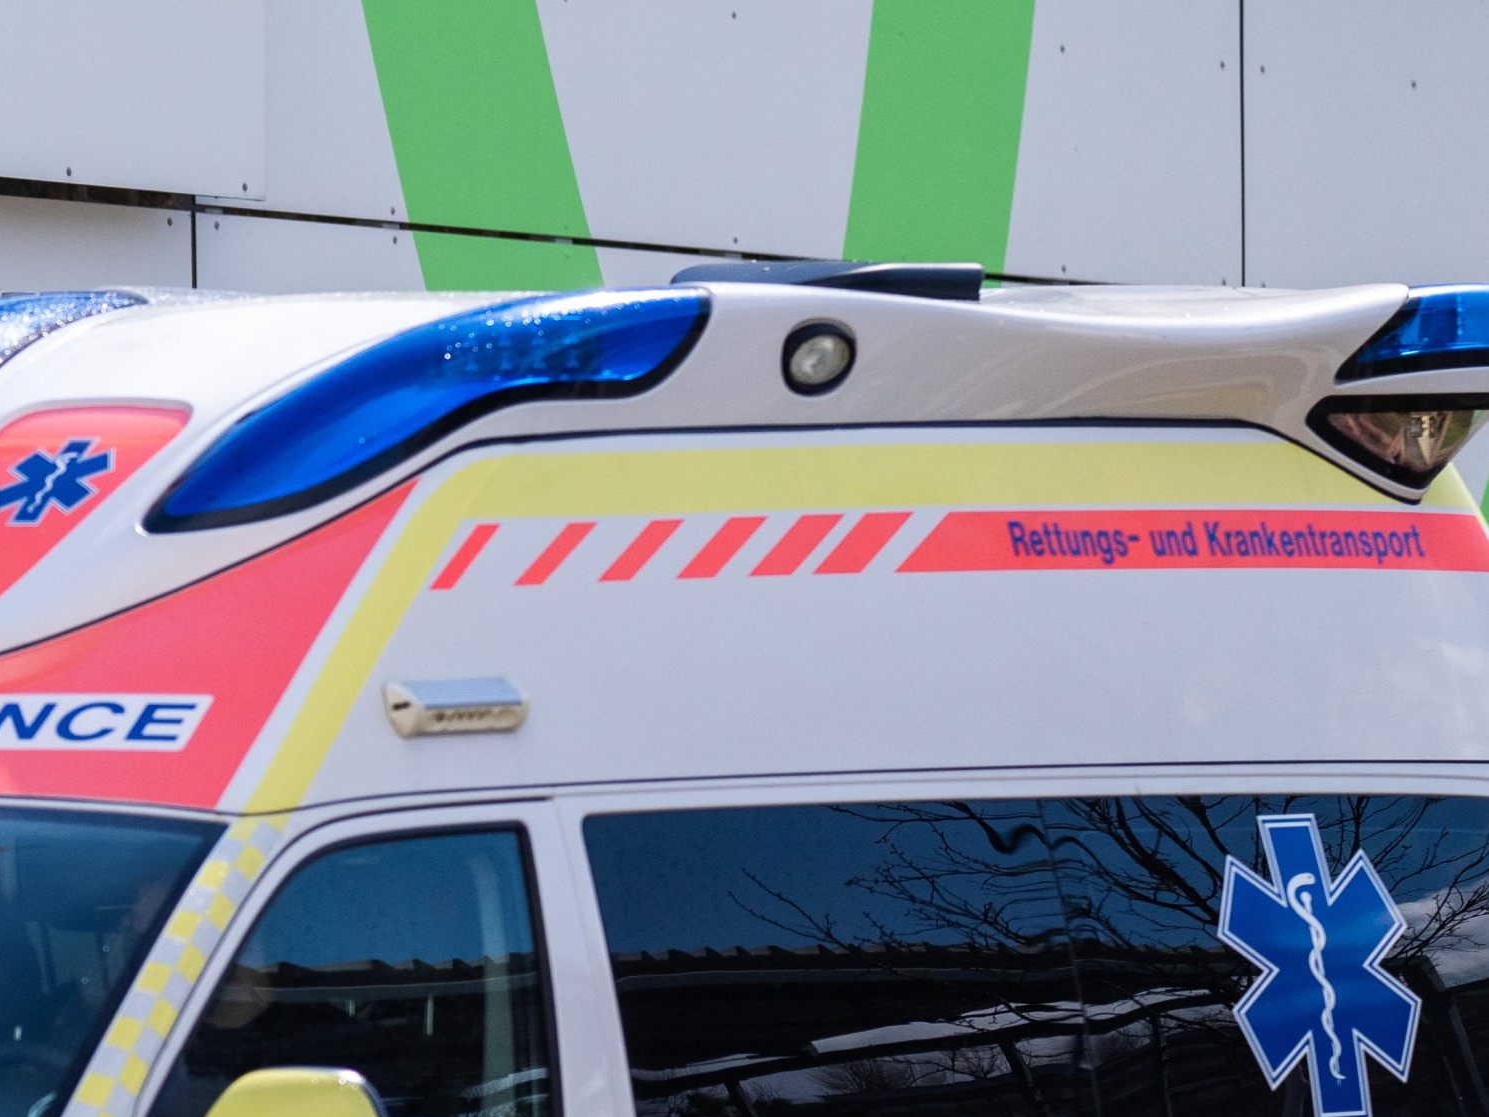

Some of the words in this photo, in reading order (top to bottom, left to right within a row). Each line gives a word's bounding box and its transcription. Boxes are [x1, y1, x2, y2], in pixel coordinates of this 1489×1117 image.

[1007, 519, 1140, 566] Rettungs-
[1149, 525, 1199, 557] und
[1206, 520, 1425, 565] Krankentransport
